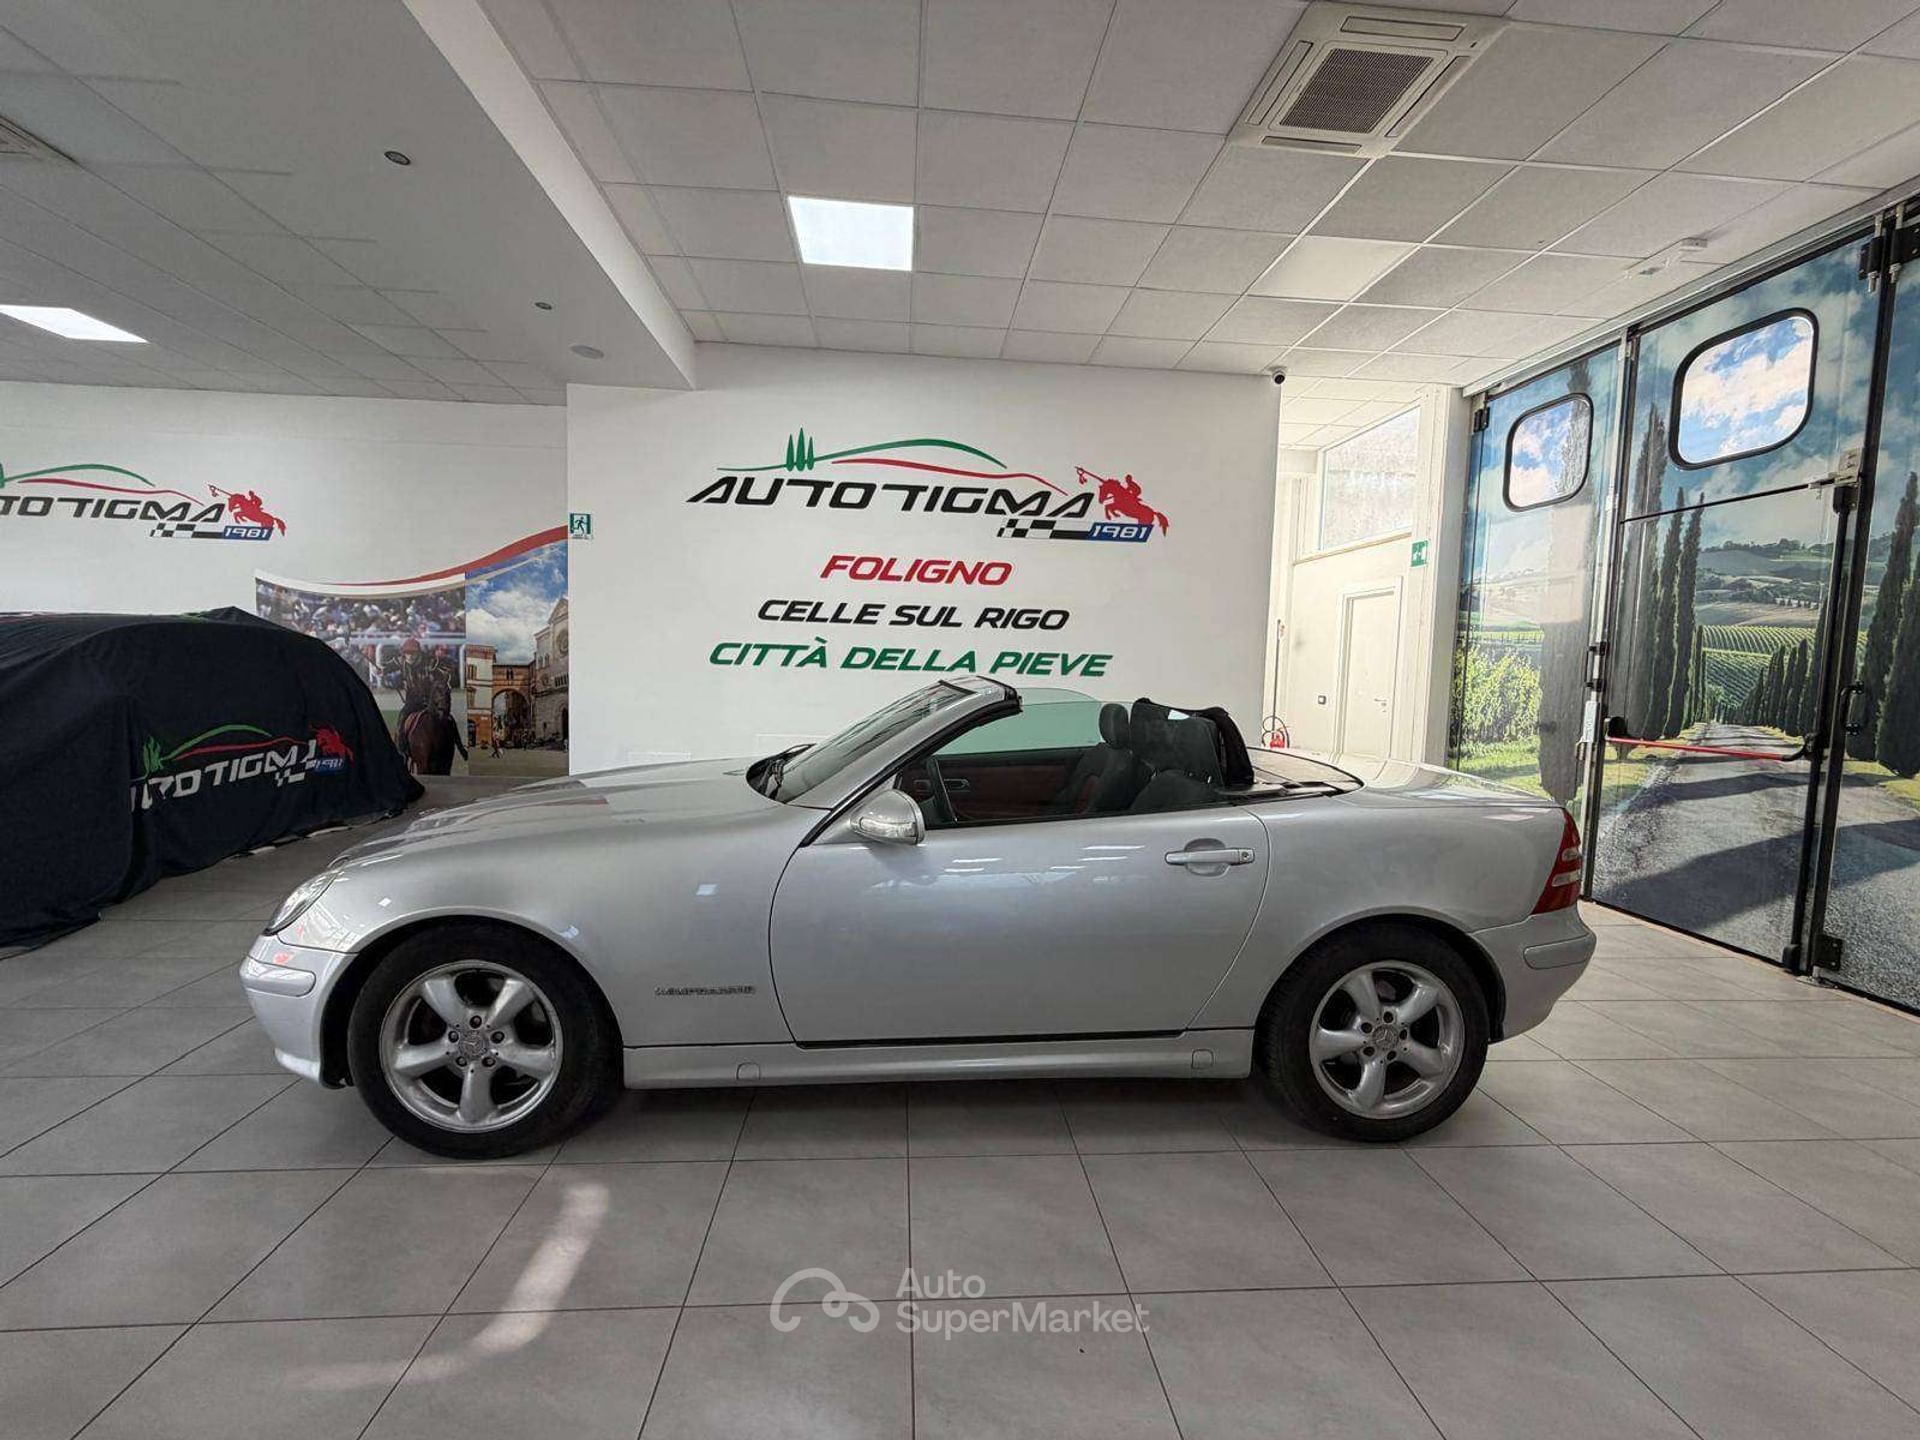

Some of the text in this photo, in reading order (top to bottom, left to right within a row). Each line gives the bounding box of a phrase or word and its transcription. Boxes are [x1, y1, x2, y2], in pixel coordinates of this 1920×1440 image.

[224, 527, 269, 539] 1981
[1092, 525, 1147, 539] 1981
[820, 555, 1013, 585] FOLIGNO
[757, 599, 1070, 630] CELLE SUL RIGO
[709, 636, 1113, 677] CITTÀ DELLA PIEVE
